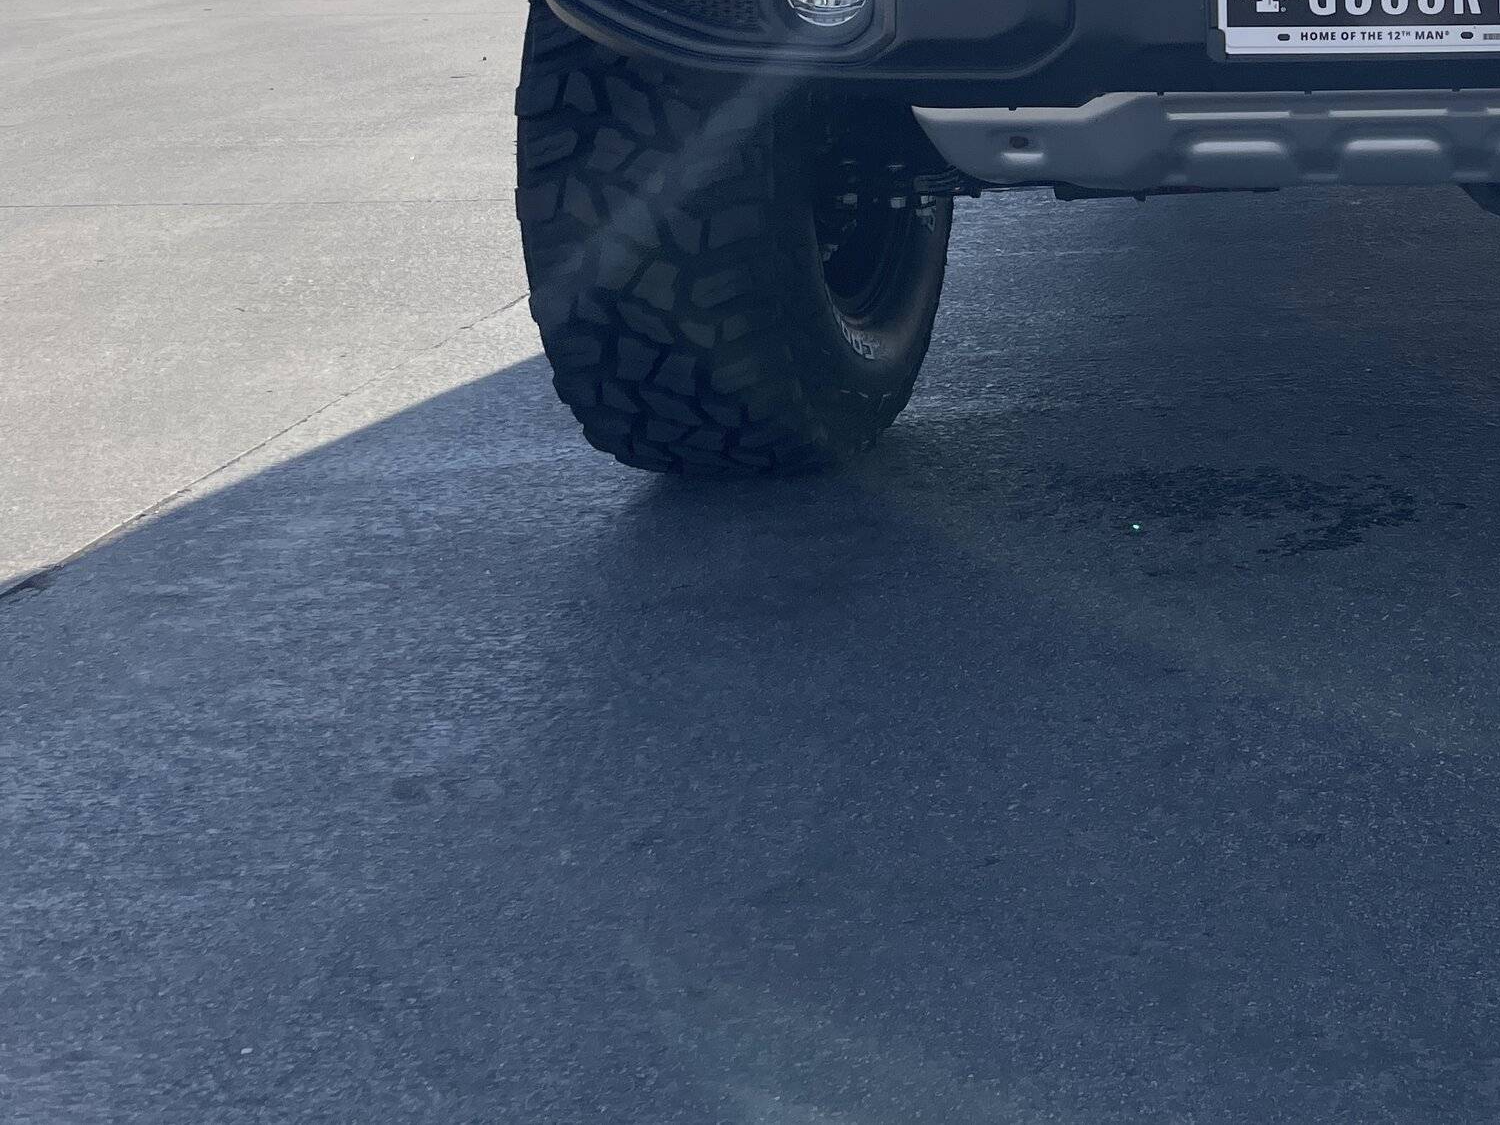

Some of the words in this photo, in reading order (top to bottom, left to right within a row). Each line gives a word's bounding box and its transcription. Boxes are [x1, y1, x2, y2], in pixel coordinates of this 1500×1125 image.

[1300, 31, 1337, 42] HOME
[1340, 31, 1358, 42] OF
[1358, 31, 1383, 41] THE
